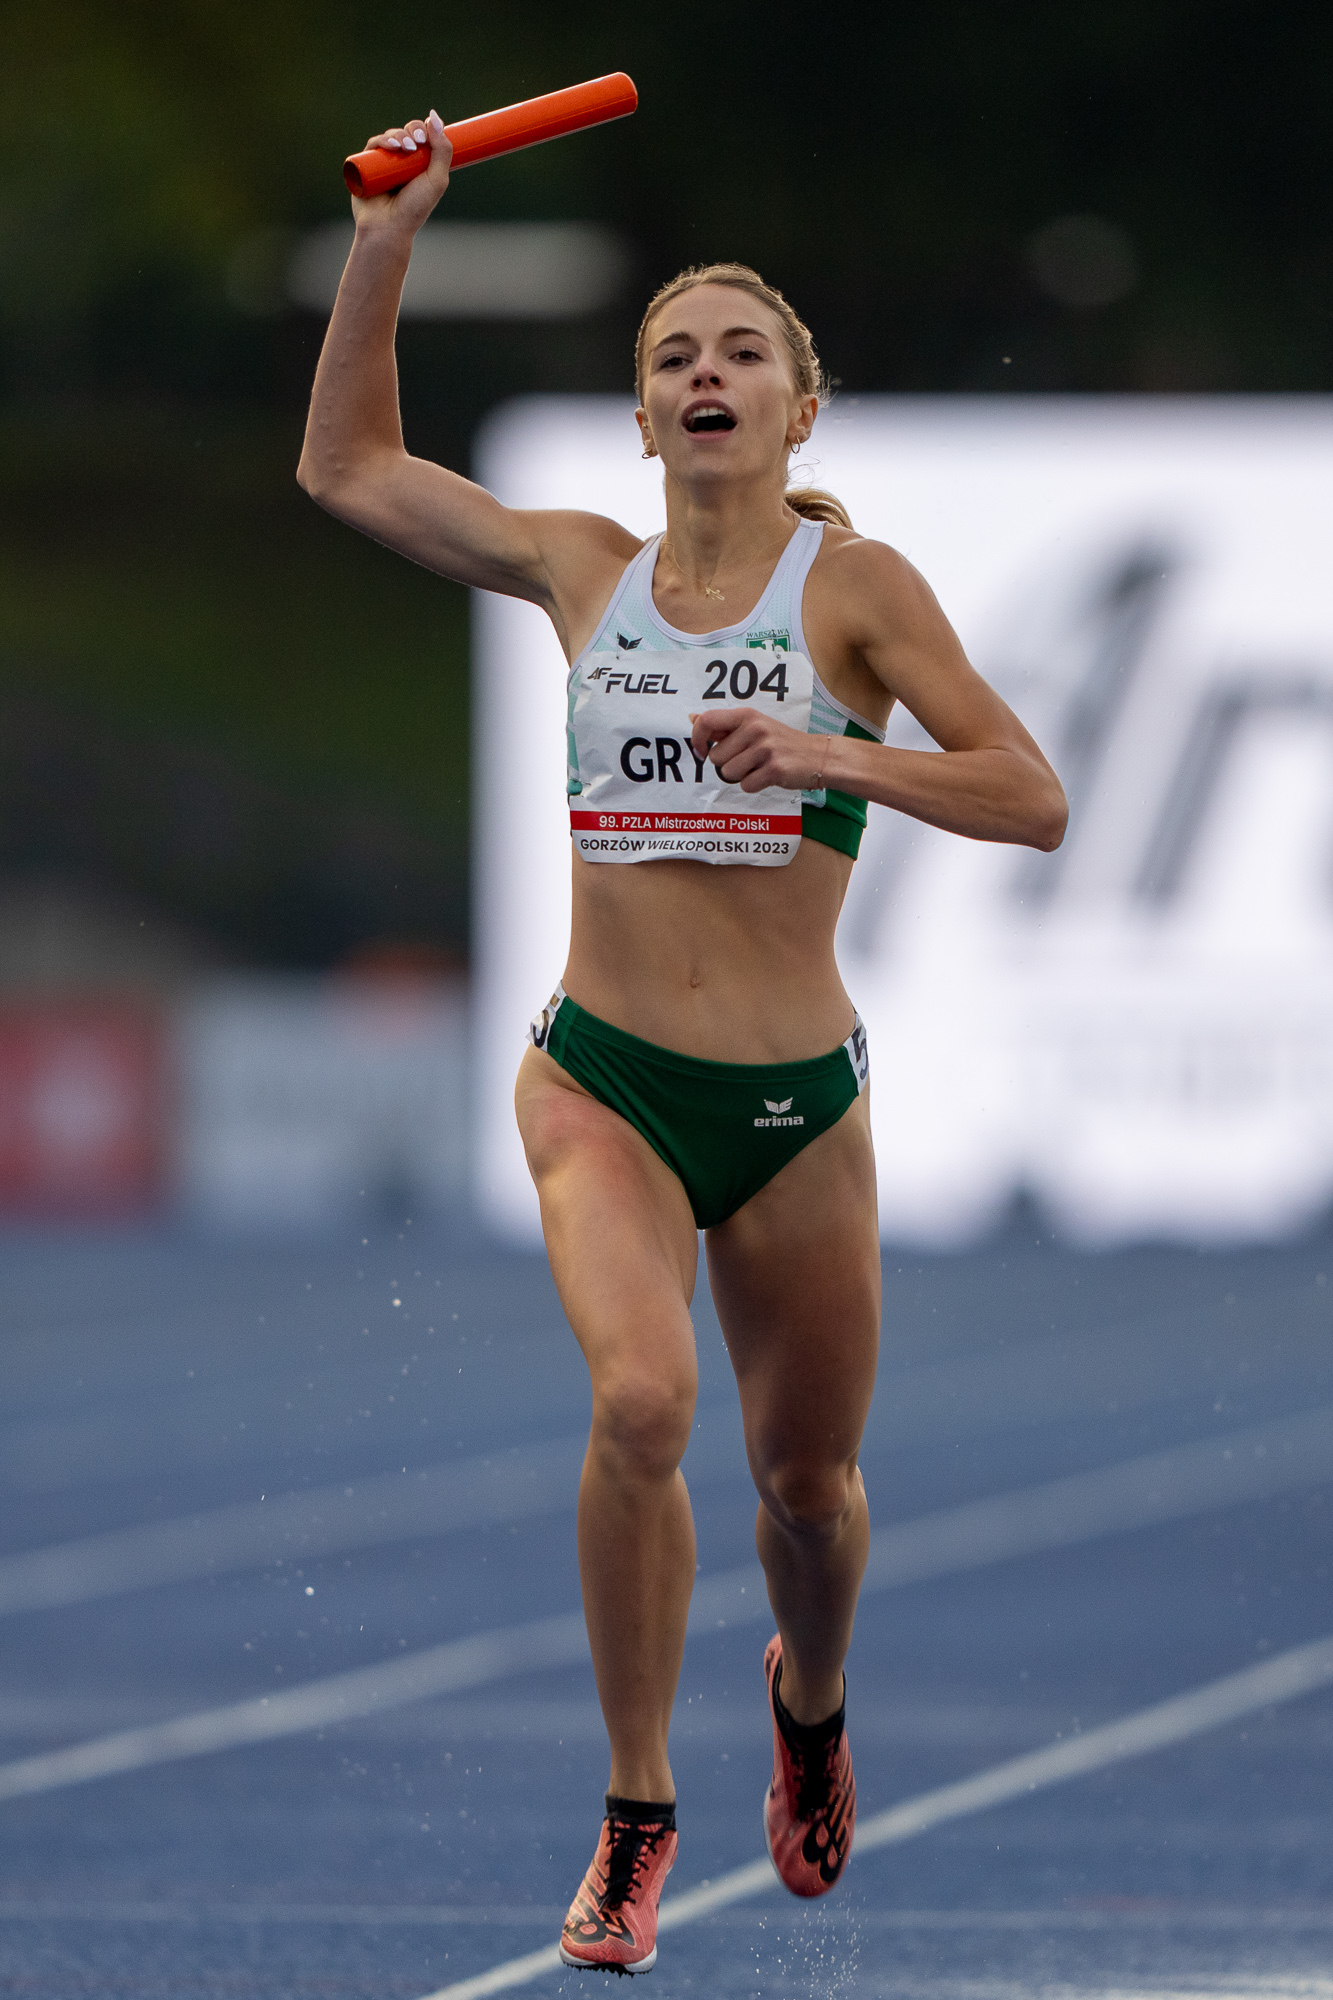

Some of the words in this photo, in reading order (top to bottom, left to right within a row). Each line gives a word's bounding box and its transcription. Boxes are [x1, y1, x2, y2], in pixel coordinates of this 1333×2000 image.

[605, 673, 679, 694] FUEL
[702, 660, 789, 702] 204
[599, 815, 619, 828] 99.
[622, 816, 652, 829] PZLA
[655, 816, 726, 829] Mistrzostwa
[729, 818, 770, 831] Polski
[580, 836, 646, 851] GORZÓW
[647, 840, 749, 853] WIELKOPOLSKI
[753, 842, 790, 854] 2023
[851, 1027, 869, 1081] 5
[754, 1115, 804, 1128] erima
